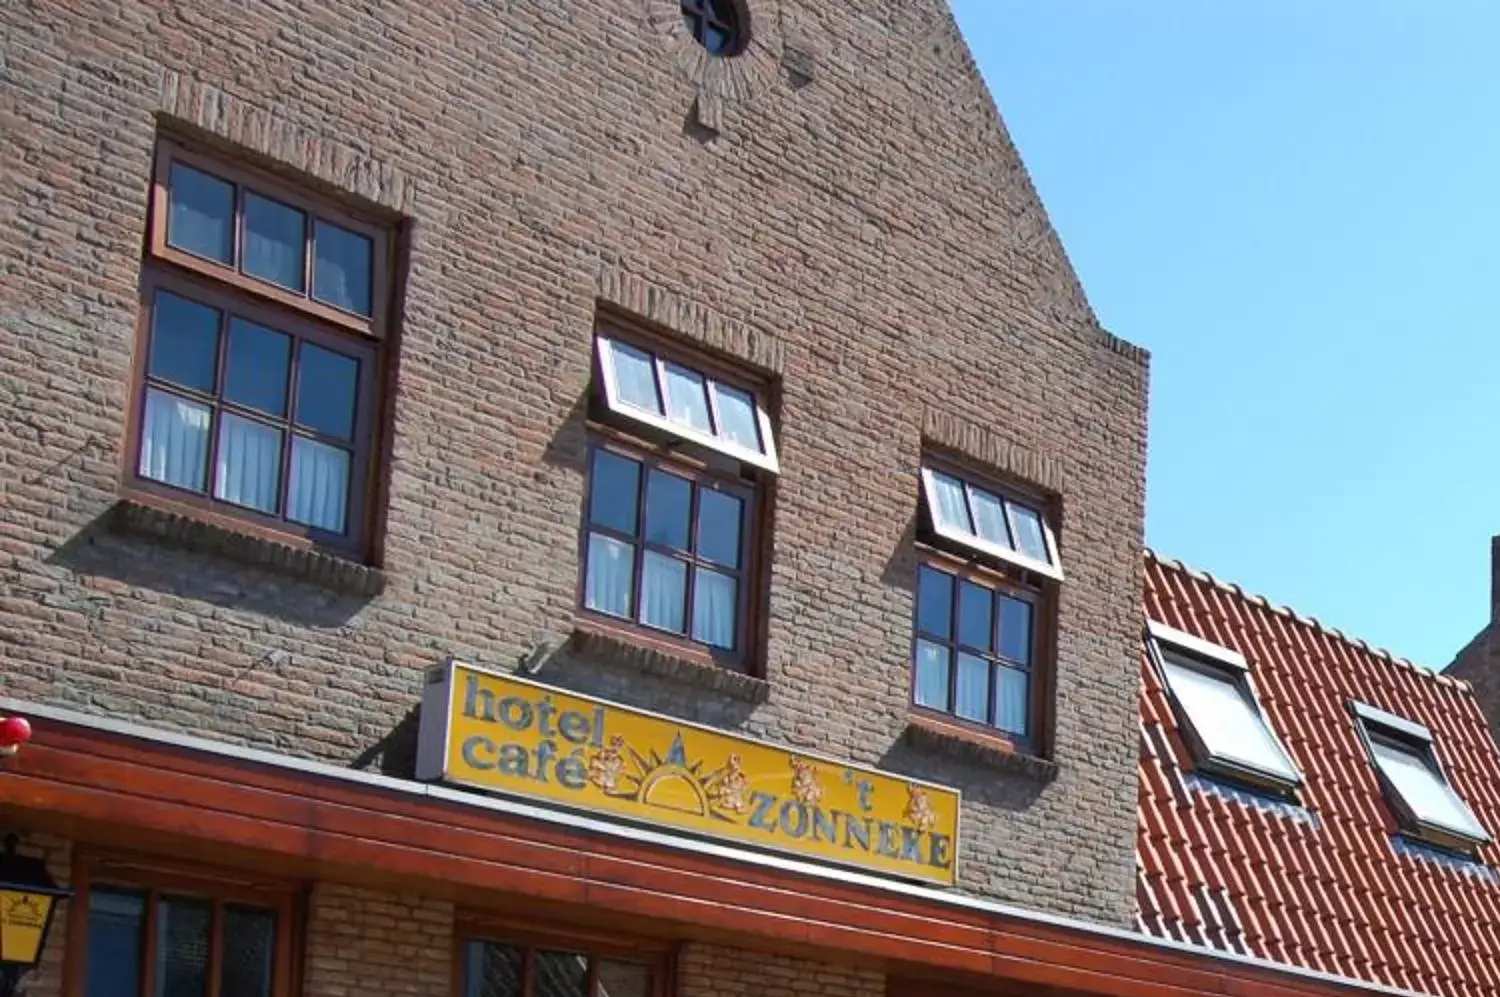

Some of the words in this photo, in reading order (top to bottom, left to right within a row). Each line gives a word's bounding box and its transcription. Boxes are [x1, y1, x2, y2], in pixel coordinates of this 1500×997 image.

[463, 671, 605, 748] hotel
[462, 734, 588, 790] café
[748, 790, 951, 870] ZONNEKE
